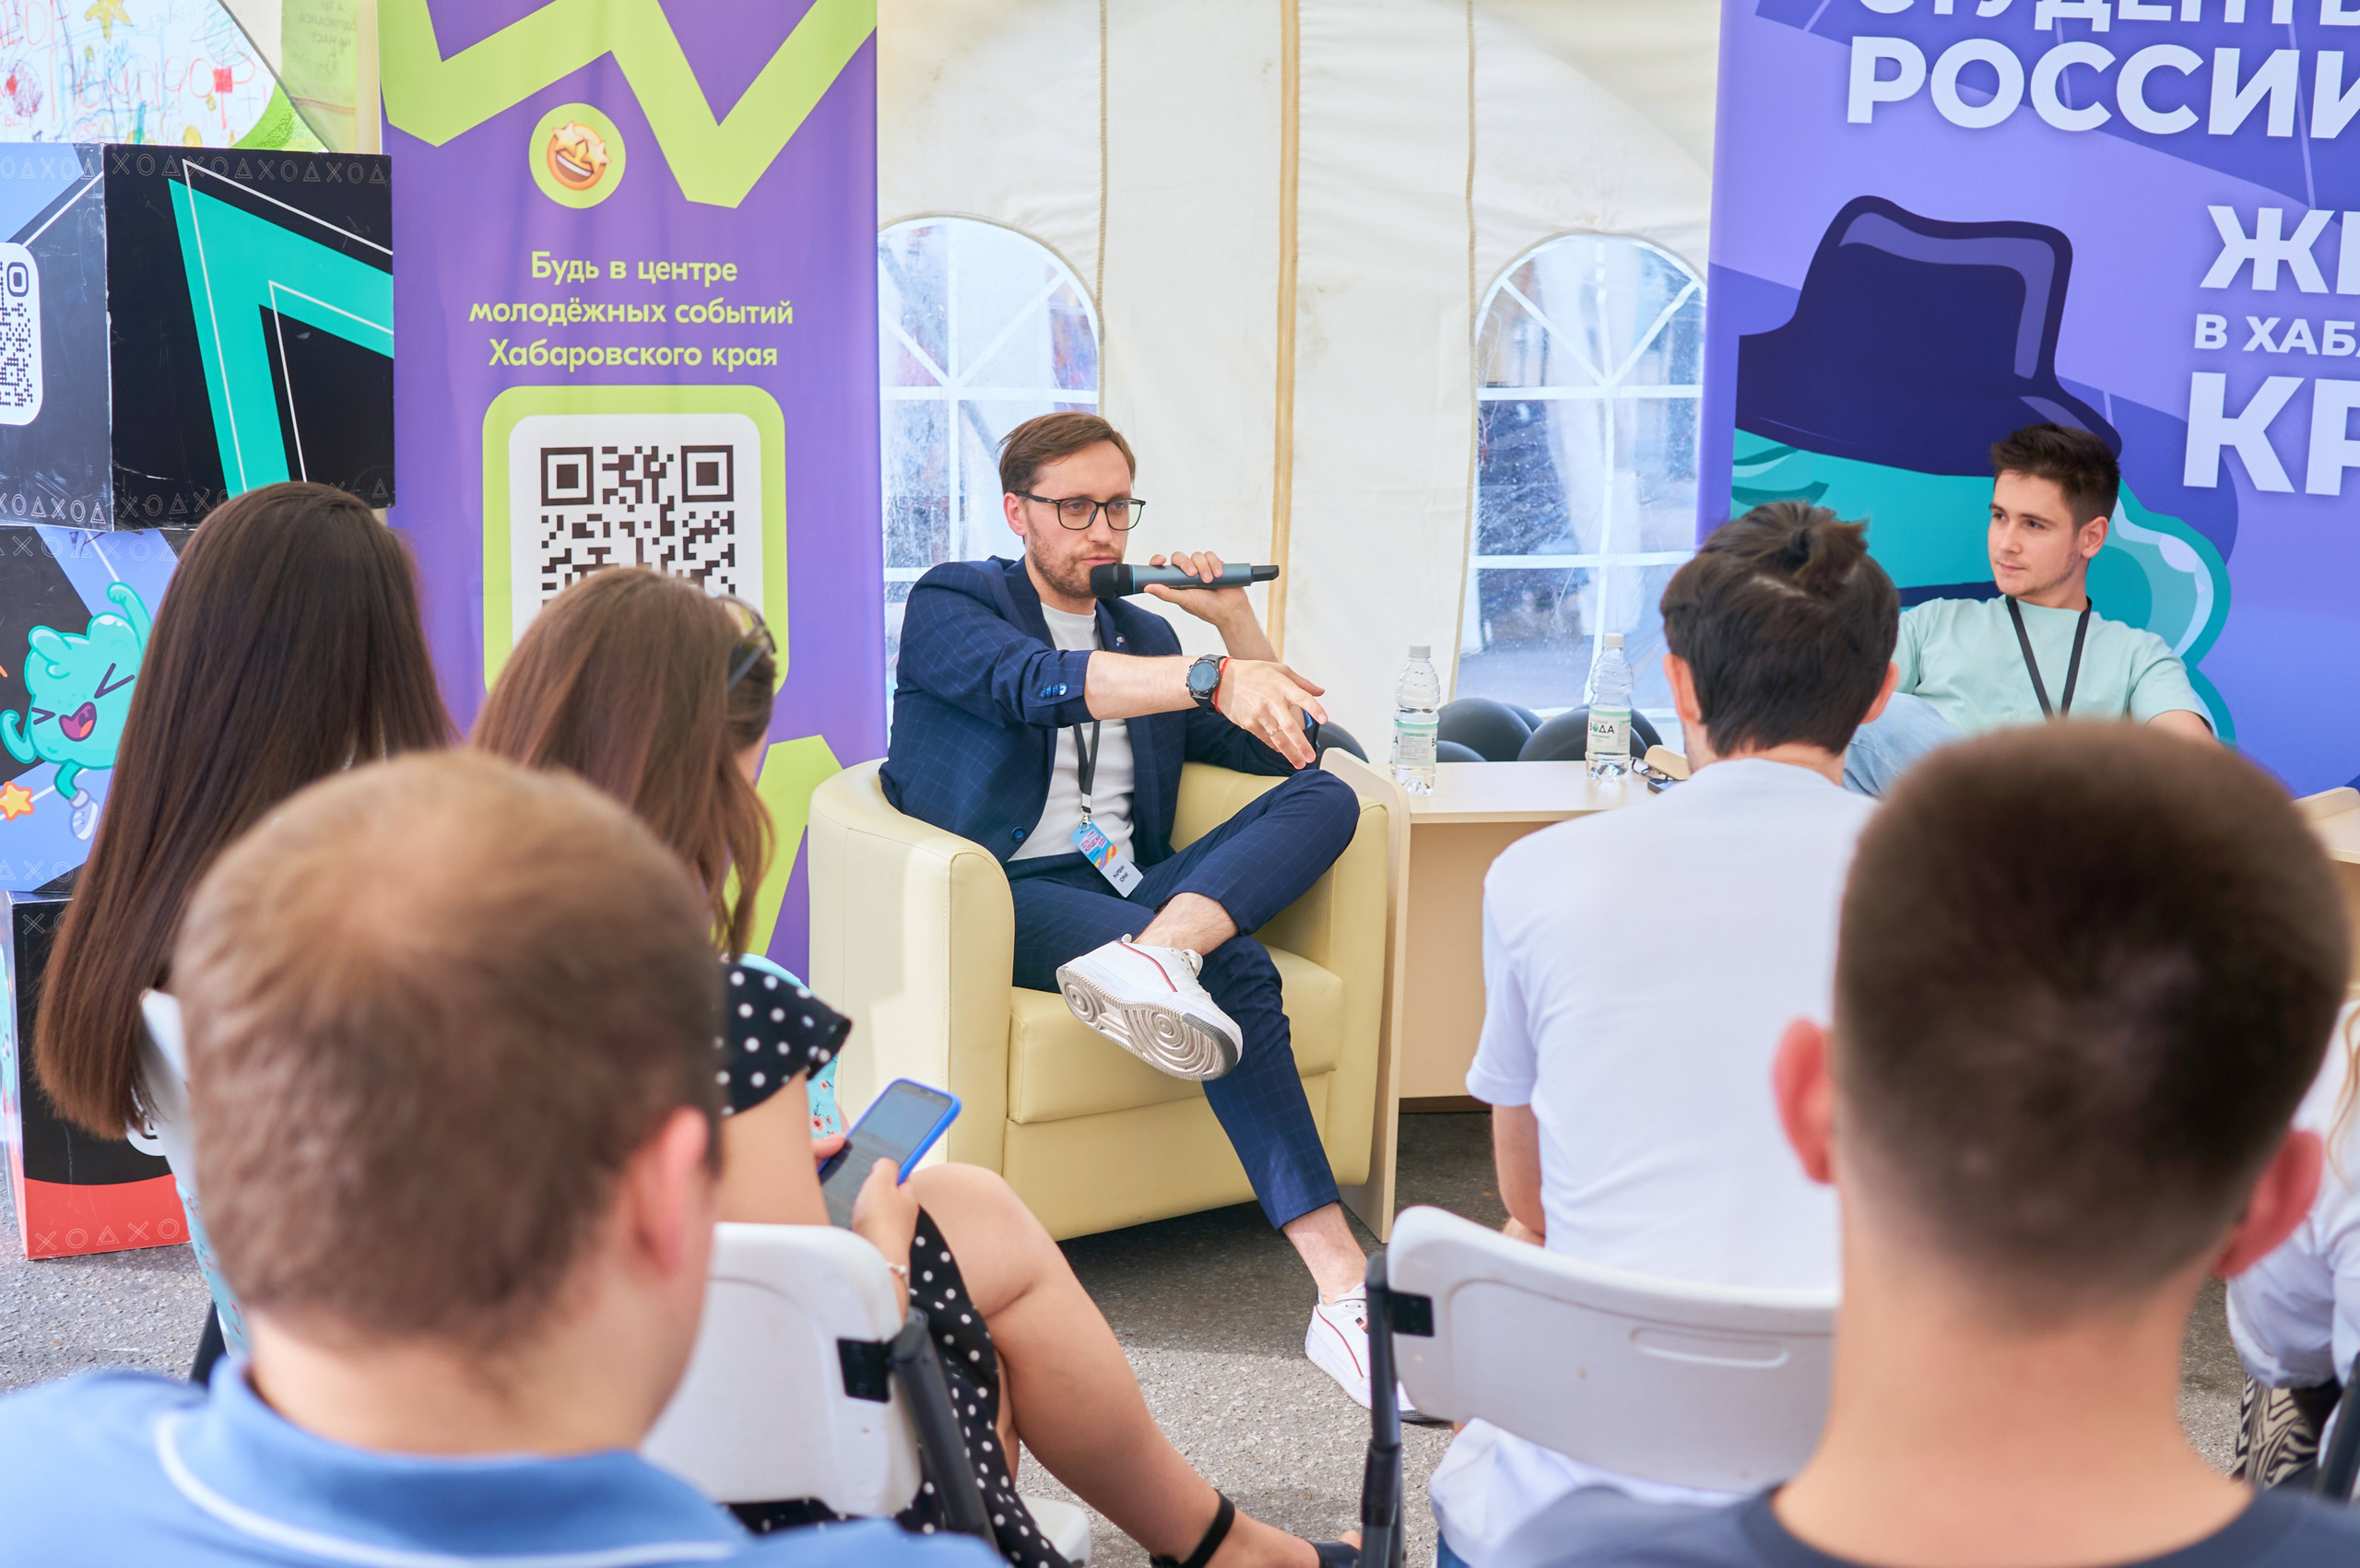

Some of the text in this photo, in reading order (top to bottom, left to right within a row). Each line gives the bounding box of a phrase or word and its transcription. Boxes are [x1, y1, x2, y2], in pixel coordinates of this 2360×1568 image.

[531, 251, 738, 288] Будь в центре
[468, 297, 794, 326] молодёжных событий
[2194, 313, 2360, 358] В ХАБ
[489, 338, 778, 372] Хабаровского края
